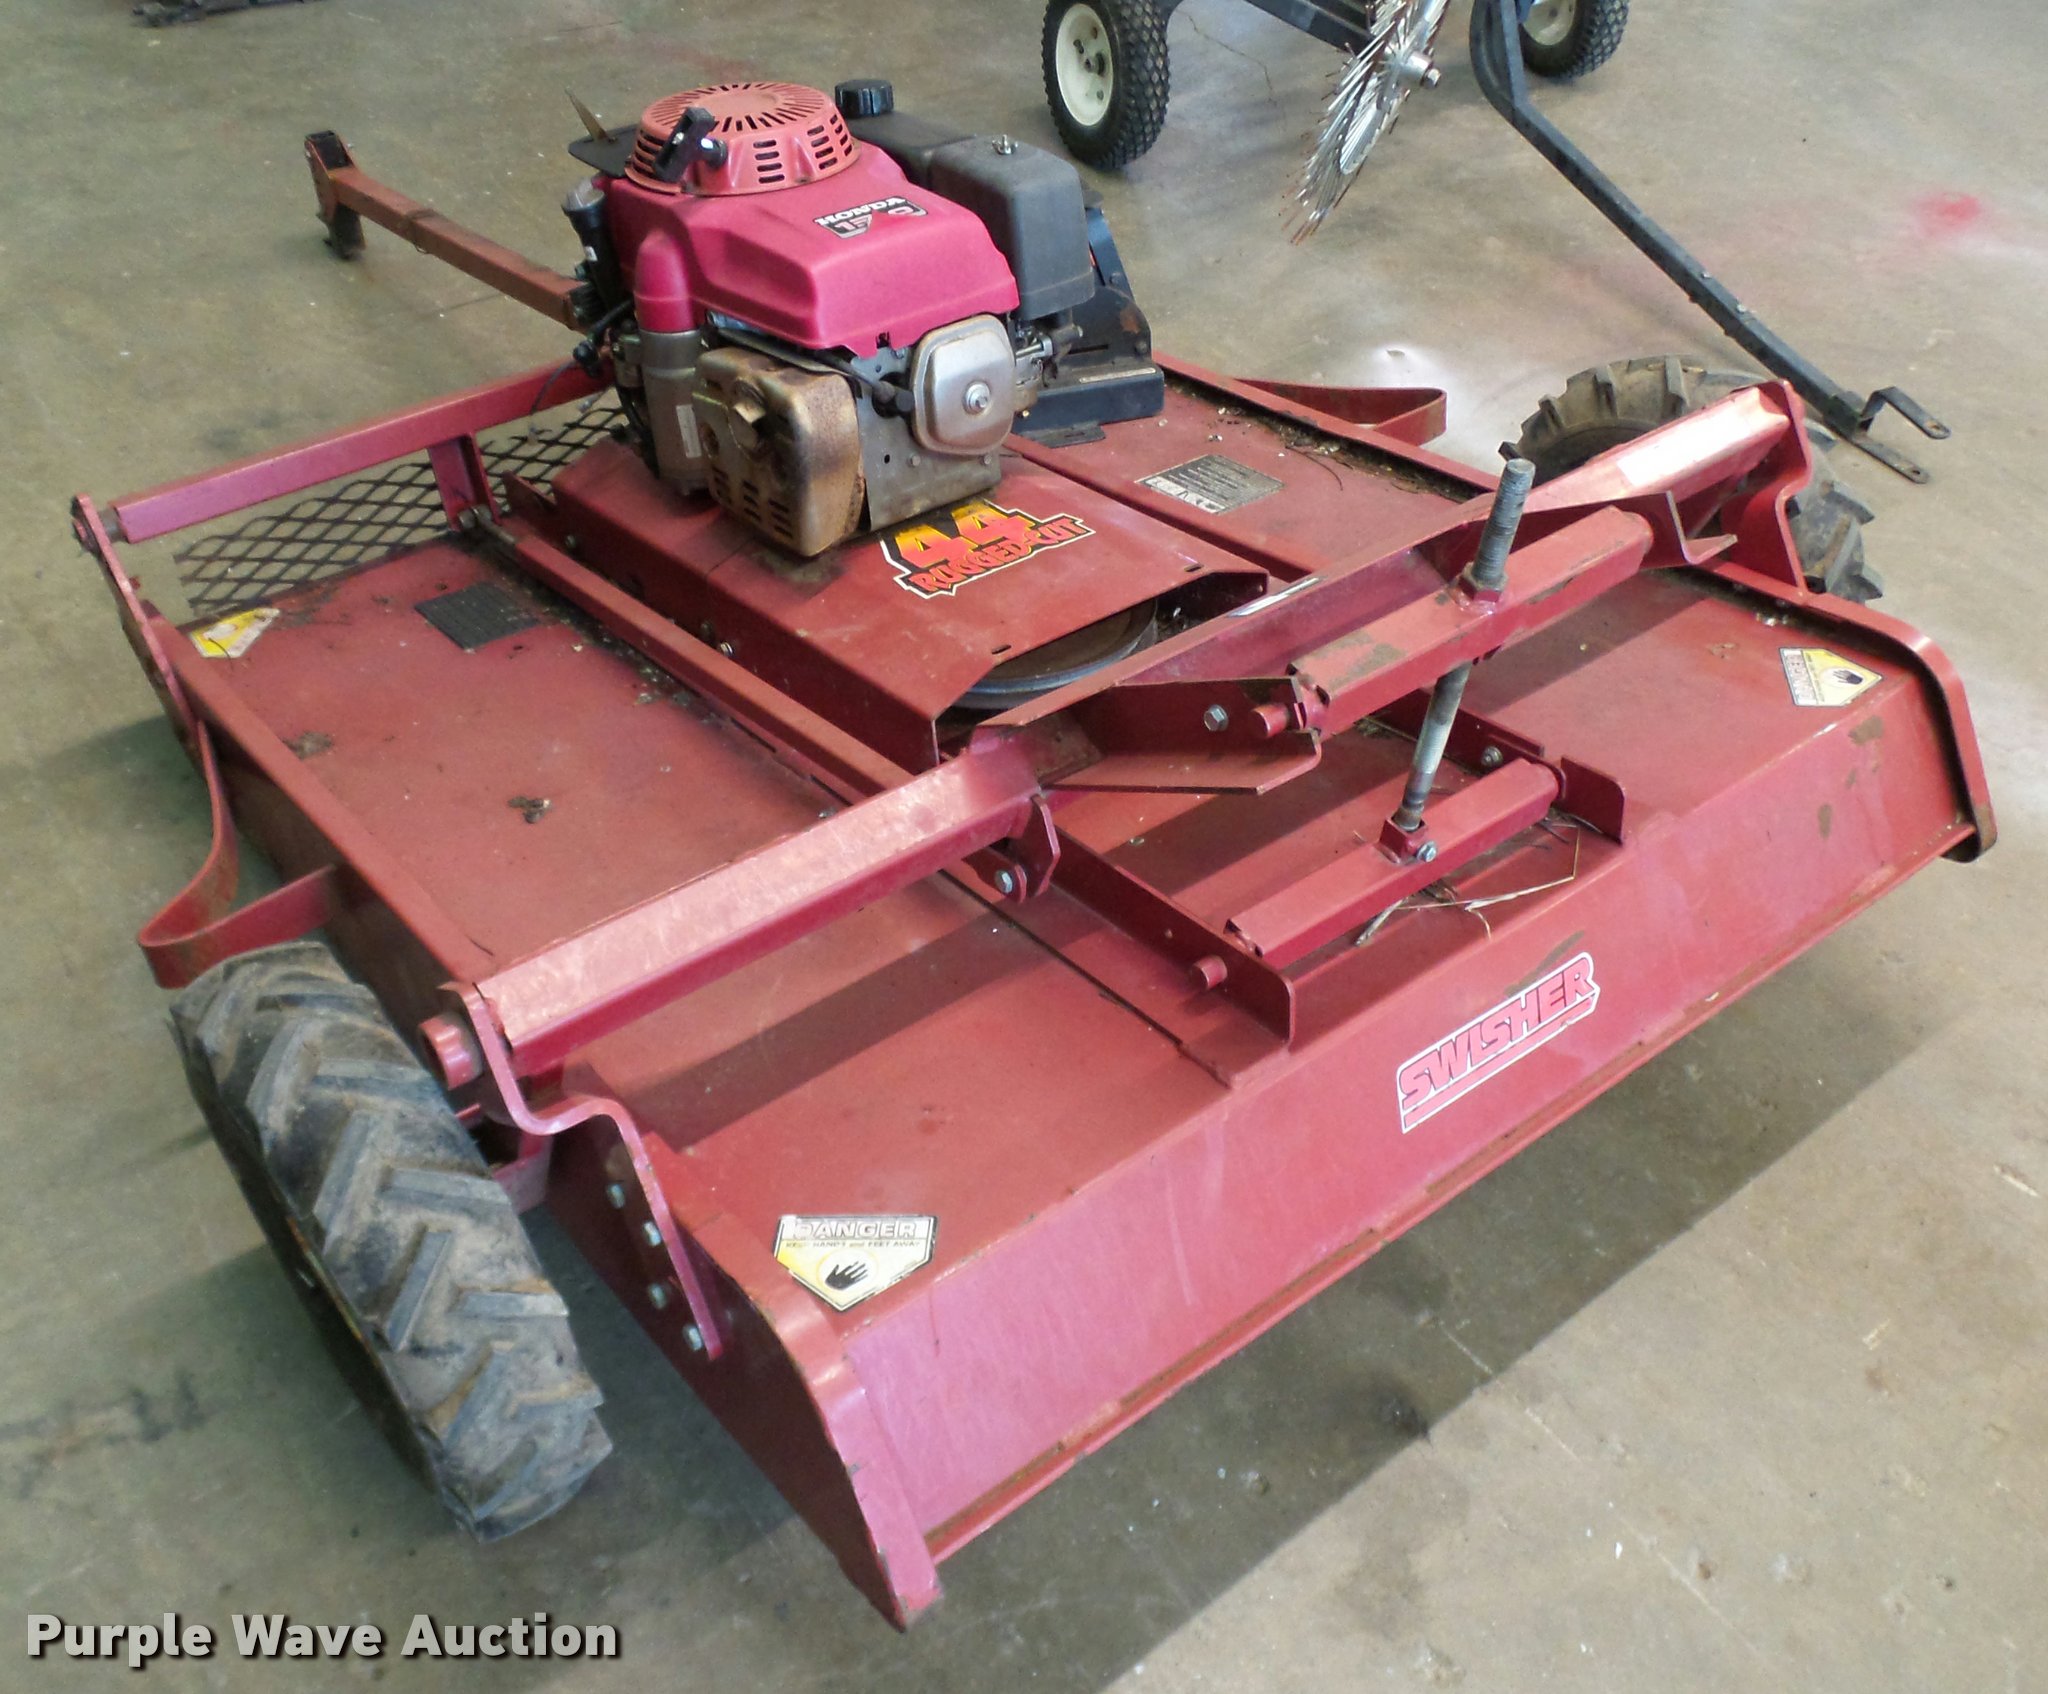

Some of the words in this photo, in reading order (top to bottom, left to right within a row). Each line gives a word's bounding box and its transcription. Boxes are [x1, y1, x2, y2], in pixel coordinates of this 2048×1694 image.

[815, 196, 906, 225] HONDA
[1398, 957, 1595, 1110] SWISHER
[793, 1220, 917, 1239] DANGER
